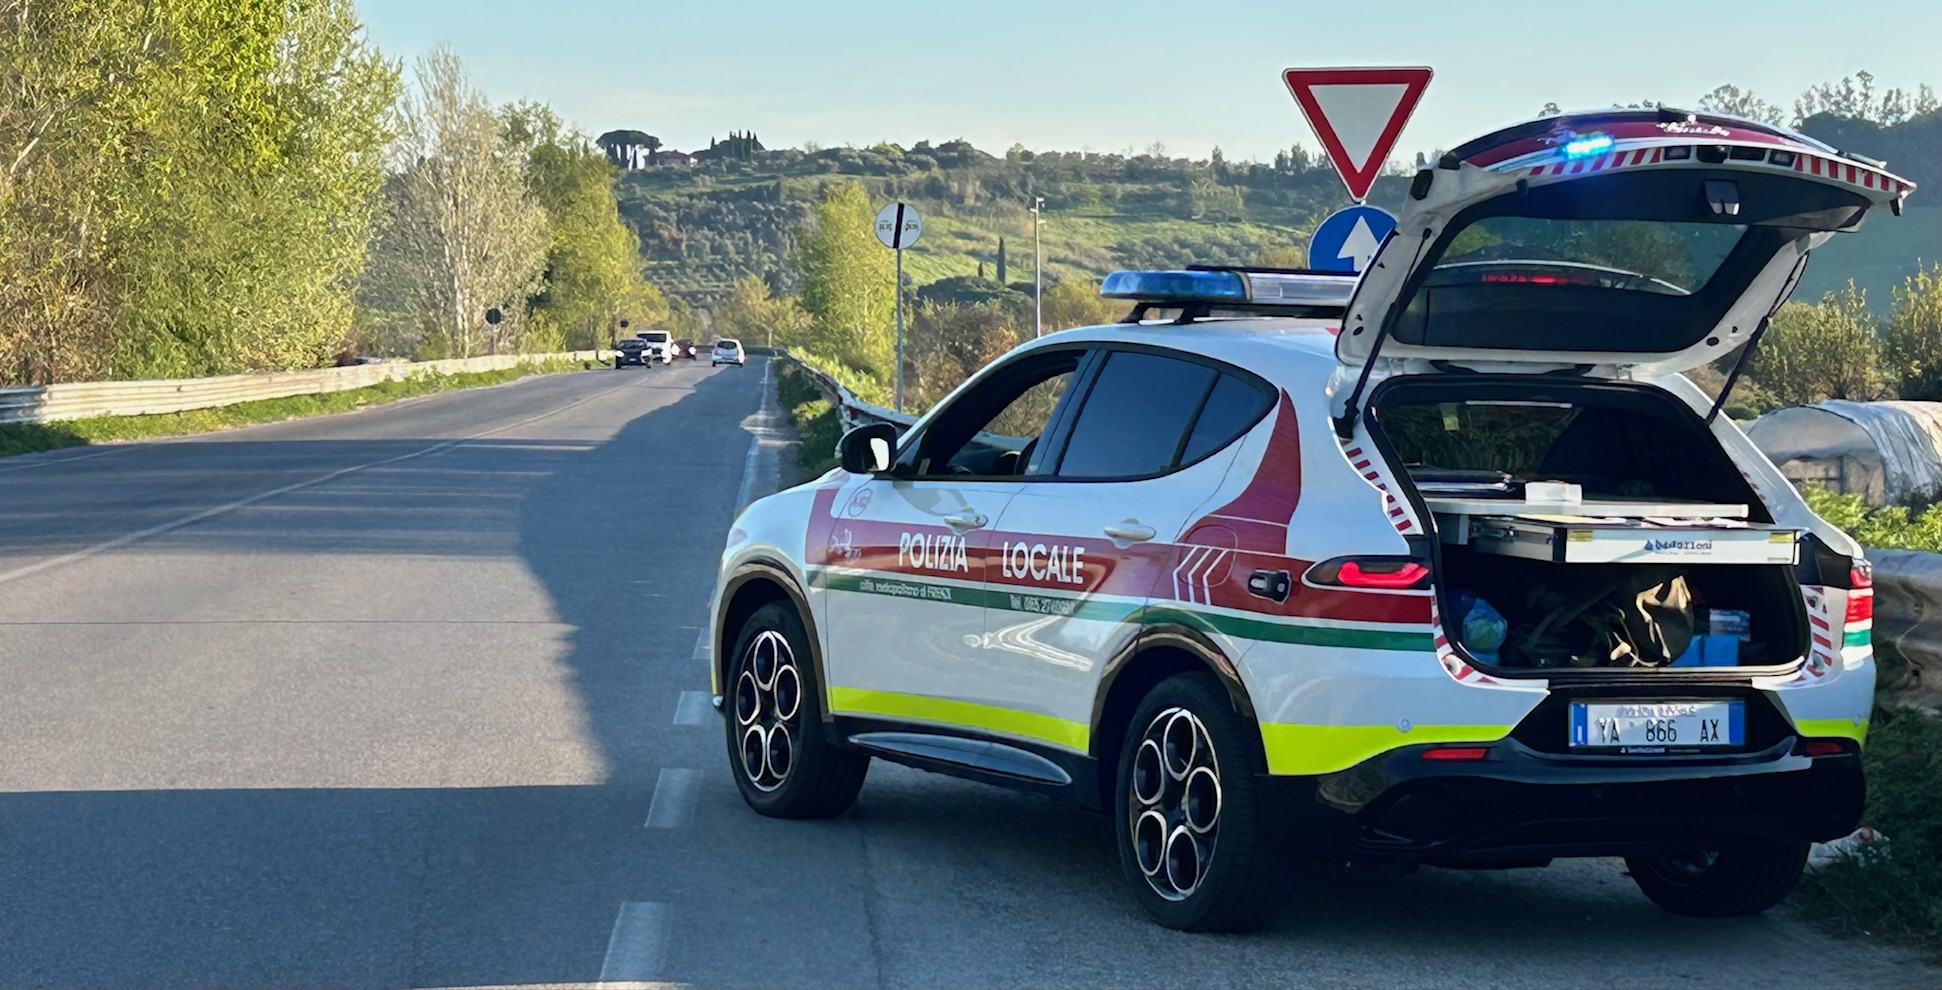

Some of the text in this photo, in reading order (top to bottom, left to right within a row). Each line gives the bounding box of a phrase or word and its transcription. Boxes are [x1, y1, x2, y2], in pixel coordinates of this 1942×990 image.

[899, 532, 1086, 584] POLIZIA LOCALE
[1597, 717, 1719, 743] YA 866 AX
